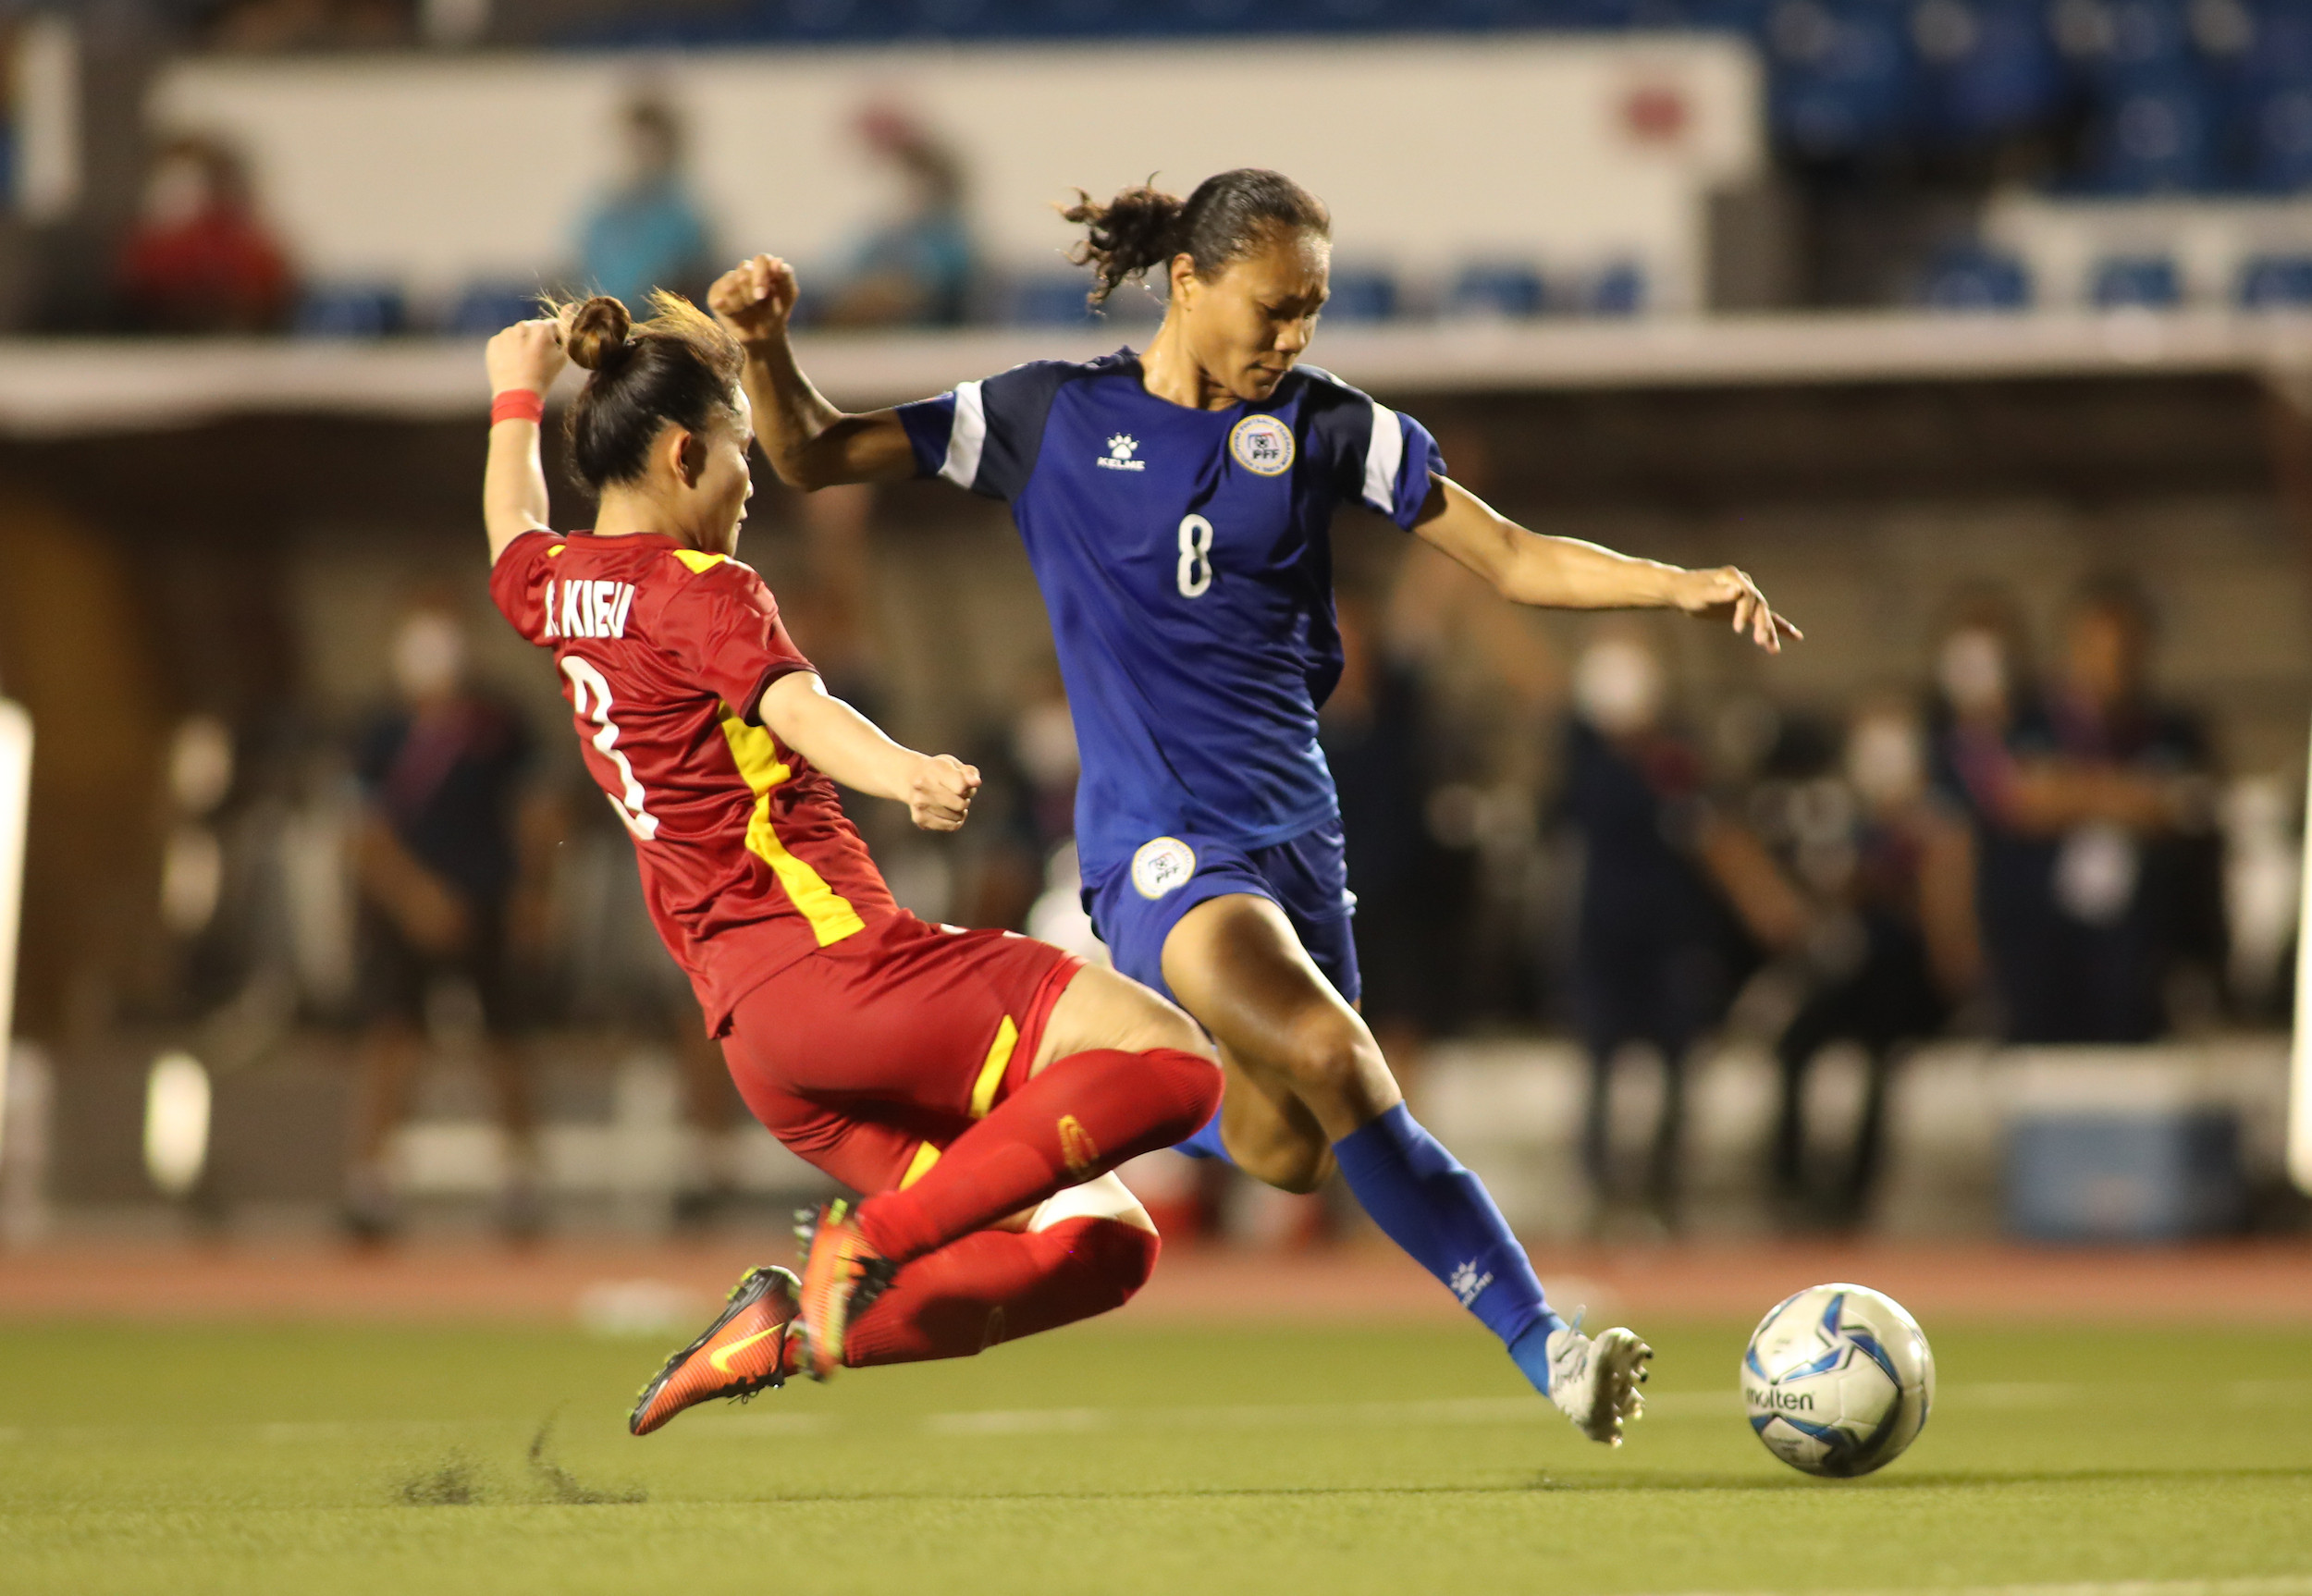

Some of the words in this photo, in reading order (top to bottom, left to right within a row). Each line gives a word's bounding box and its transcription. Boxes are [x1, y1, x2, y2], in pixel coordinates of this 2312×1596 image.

[1252, 448, 1280, 460] PFF
[1097, 457, 1146, 472] KELME
[1176, 513, 1213, 599] 8
